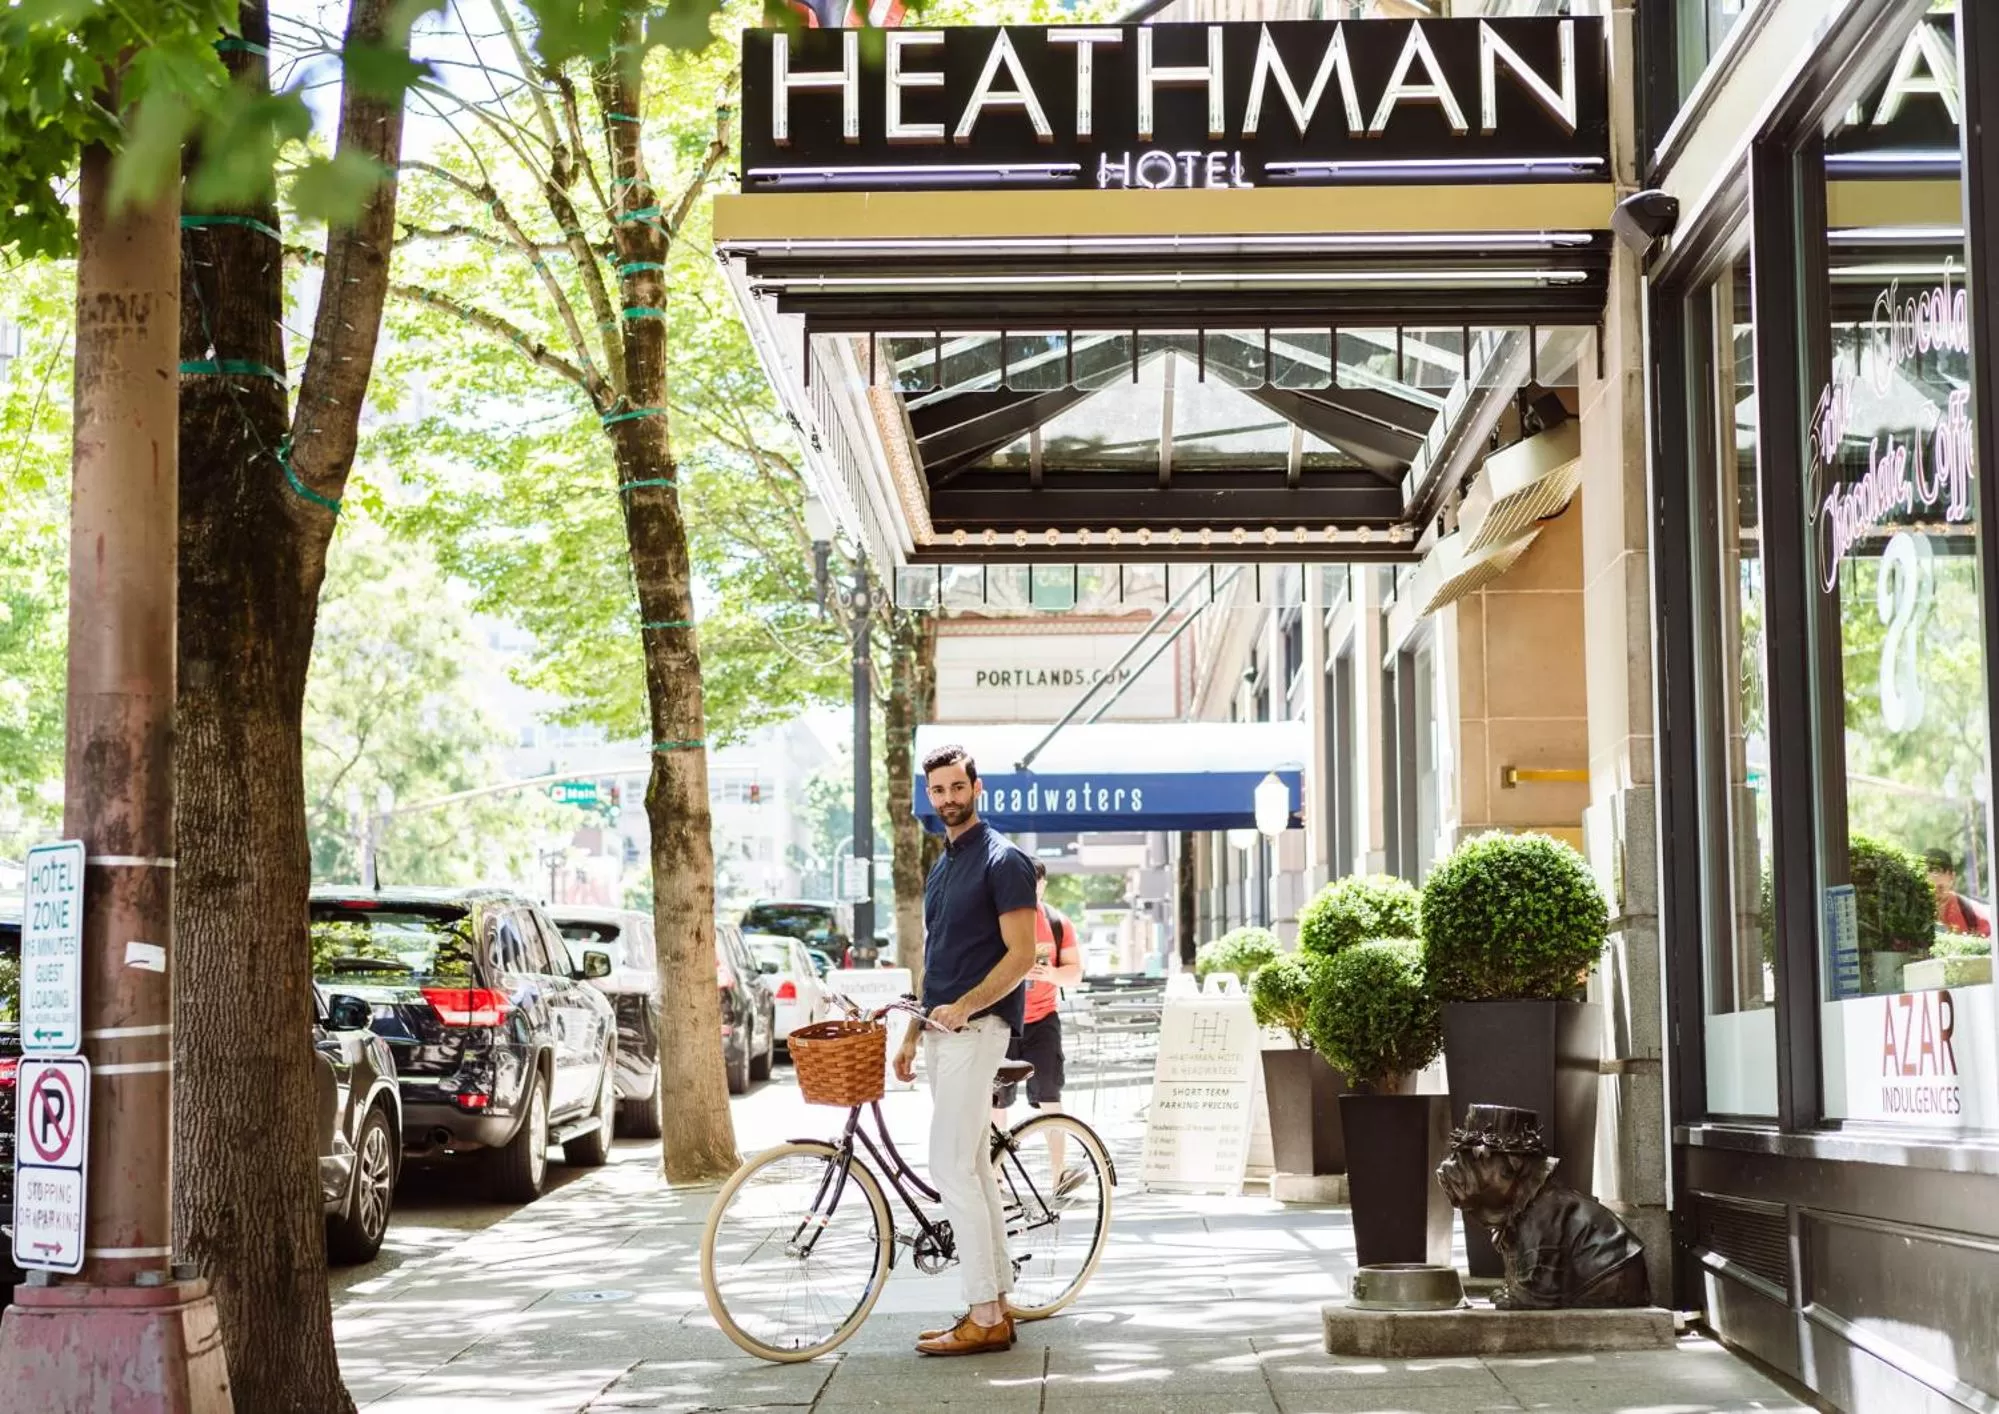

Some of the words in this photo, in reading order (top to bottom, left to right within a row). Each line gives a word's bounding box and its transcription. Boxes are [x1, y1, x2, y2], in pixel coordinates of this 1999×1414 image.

[772, 19, 1577, 145] HEATHMAN
[1099, 151, 1254, 188] HOTEL
[31, 861, 74, 895] HOTEL
[33, 900, 69, 930] ZONE
[36, 963, 64, 982] GUEST
[31, 989, 68, 1009] LOADING
[1883, 990, 1958, 1077] AZAR
[1159, 1101, 1200, 1109] PARKING
[1202, 1101, 1239, 1109] PRICING
[1172, 1088, 1202, 1096] SHORT
[1205, 1087, 1230, 1096] TERM
[1881, 1086, 1961, 1115] INDULGENCES
[27, 1180, 72, 1204] STOPPING
